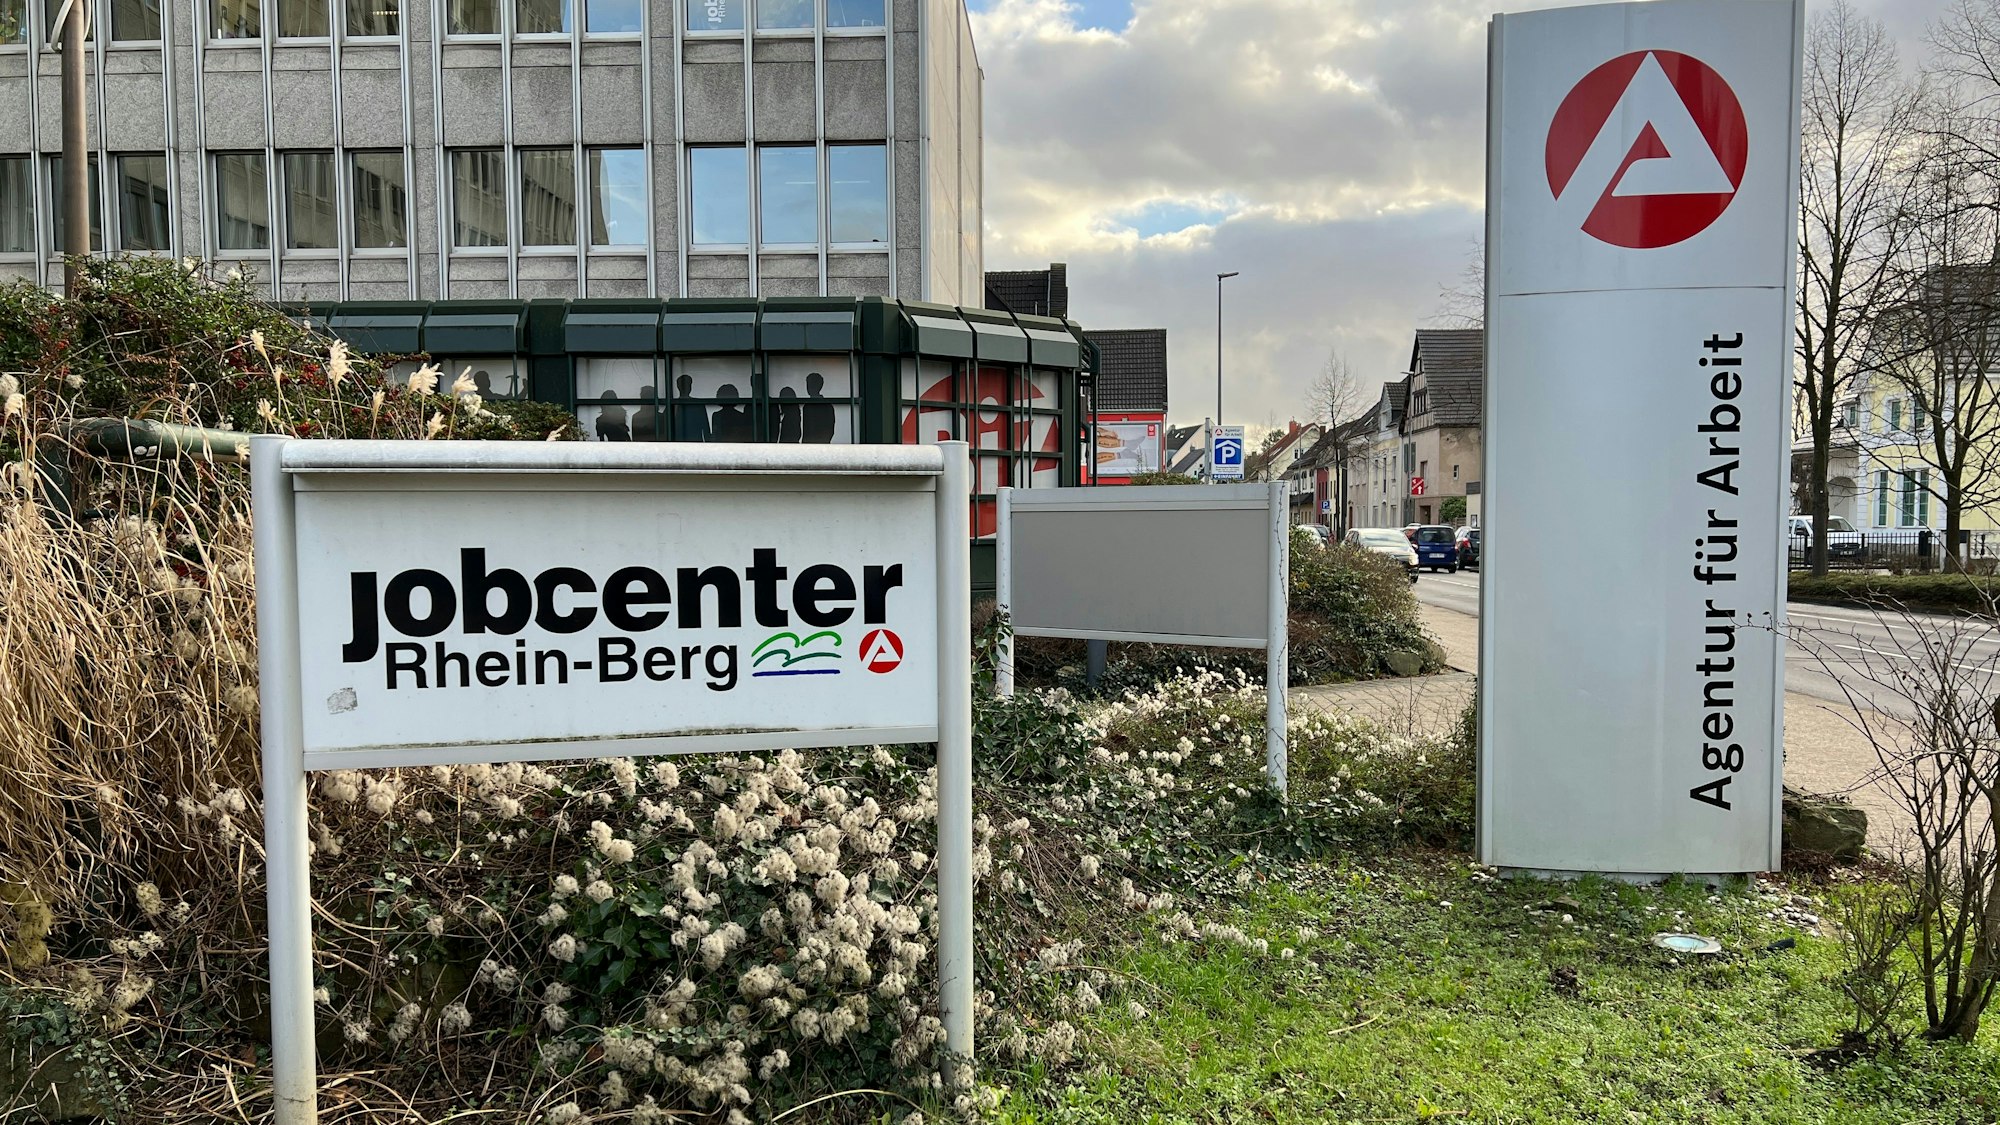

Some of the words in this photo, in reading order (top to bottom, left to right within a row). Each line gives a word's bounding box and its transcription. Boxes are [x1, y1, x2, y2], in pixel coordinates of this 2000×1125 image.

[1222, 446, 1236, 463] P
[1697, 332, 1744, 497] Arbeit
[1694, 510, 1738, 586] für
[342, 547, 903, 663] jobcenter
[385, 635, 738, 692] Rhein-Berg
[1690, 600, 1745, 811] Agentur
